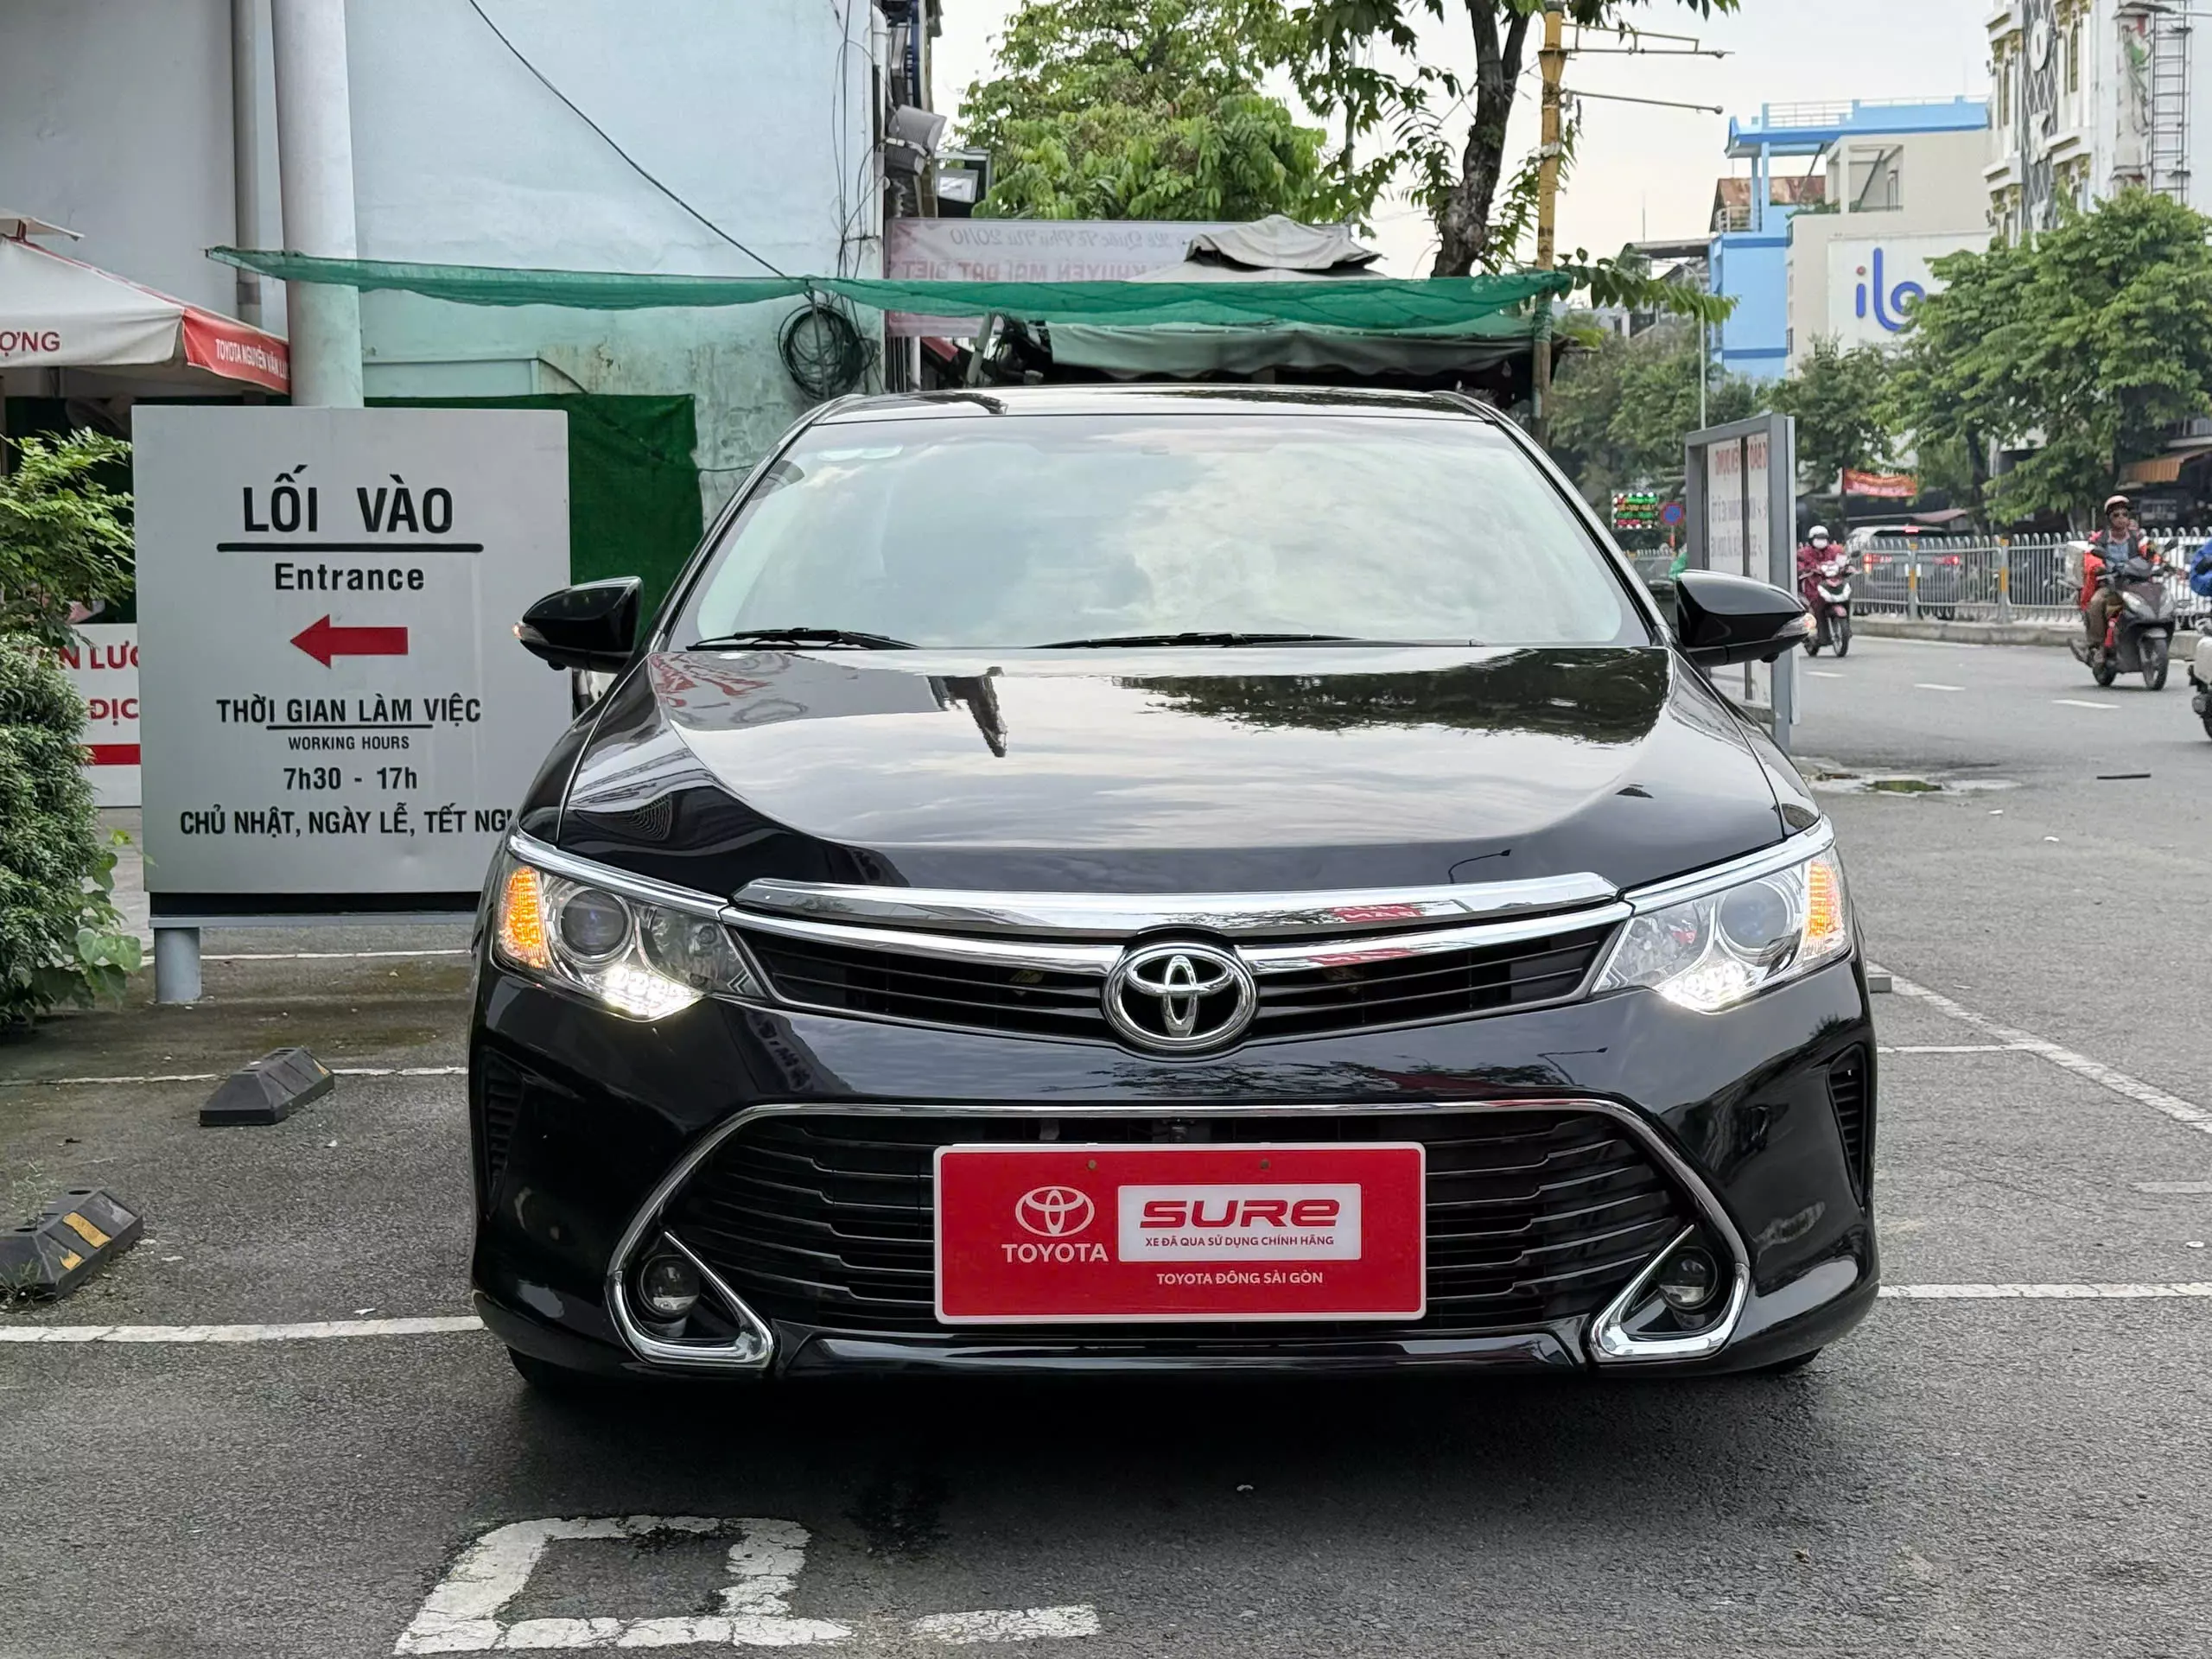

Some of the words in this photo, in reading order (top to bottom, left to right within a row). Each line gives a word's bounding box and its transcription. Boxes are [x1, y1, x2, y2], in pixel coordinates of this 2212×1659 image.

[215, 339, 242, 363] TOYOTA
[243, 464, 318, 533] LỐI
[357, 474, 454, 534] VÀO
[275, 563, 424, 591] Entrance
[216, 694, 276, 724] THỜI
[286, 698, 346, 723] GIAN
[358, 693, 412, 723] LÀM
[424, 692, 481, 728] VIỆC
[288, 735, 355, 751] WORKING
[361, 735, 410, 750] HOURS
[283, 766, 341, 790] 7h30
[377, 766, 417, 790] 17h
[180, 804, 226, 835] CHỦ
[234, 805, 302, 839] NHẬT,
[308, 805, 372, 835] NGÀY
[379, 802, 416, 837] LỄ,
[424, 802, 467, 834] TẾT
[1001, 1243, 1109, 1263] TOYOTA
[1145, 1236, 1160, 1247] XE
[1161, 1234, 1179, 1247] ĐÃ
[1180, 1236, 1206, 1247] QUA
[1208, 1234, 1223, 1247] SỬ
[1225, 1236, 1259, 1249] DỤNG
[1261, 1233, 1299, 1246] CHÍNH
[1300, 1234, 1335, 1246] HÃNG
[1156, 1273, 1213, 1285] TOYOTA
[1215, 1269, 1262, 1285] ĐÔNG
[1262, 1269, 1287, 1284] SÀI
[1288, 1269, 1324, 1284] GÒN
